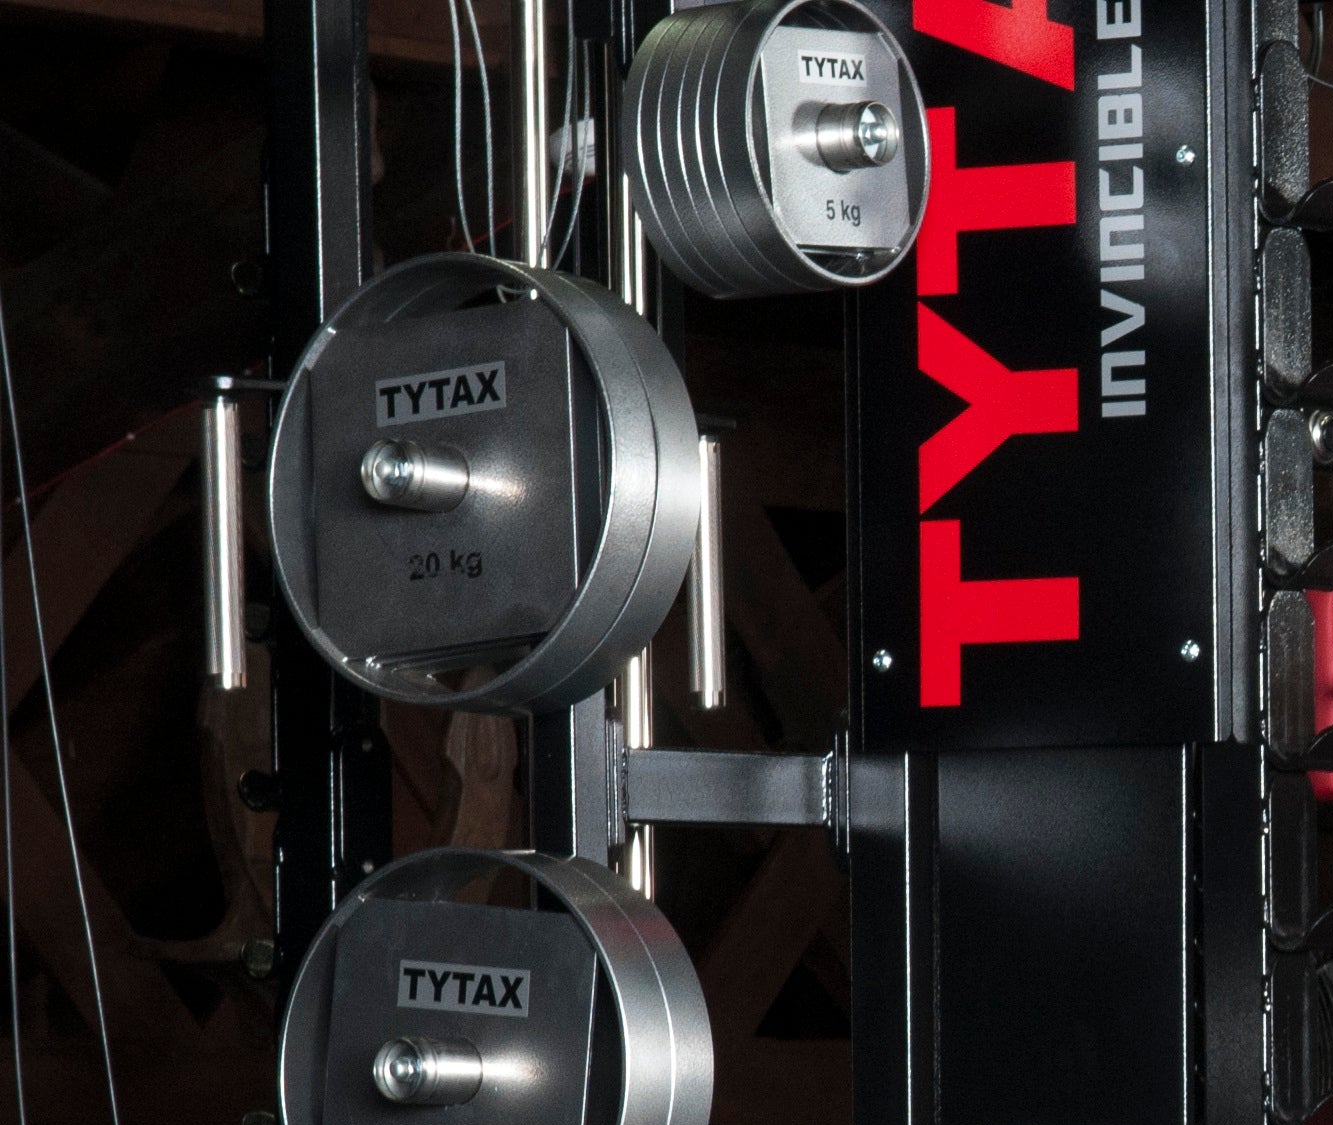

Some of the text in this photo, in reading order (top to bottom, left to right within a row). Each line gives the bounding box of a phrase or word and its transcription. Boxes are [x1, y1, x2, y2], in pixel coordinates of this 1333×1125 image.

[801, 56, 865, 81] TYTAX
[826, 200, 861, 227] 5 kg
[1096, 0, 1146, 418] INVINCIBLE
[379, 369, 501, 419] TYTAX
[408, 550, 483, 581] 20 kg
[403, 967, 524, 1009] TYTAX
